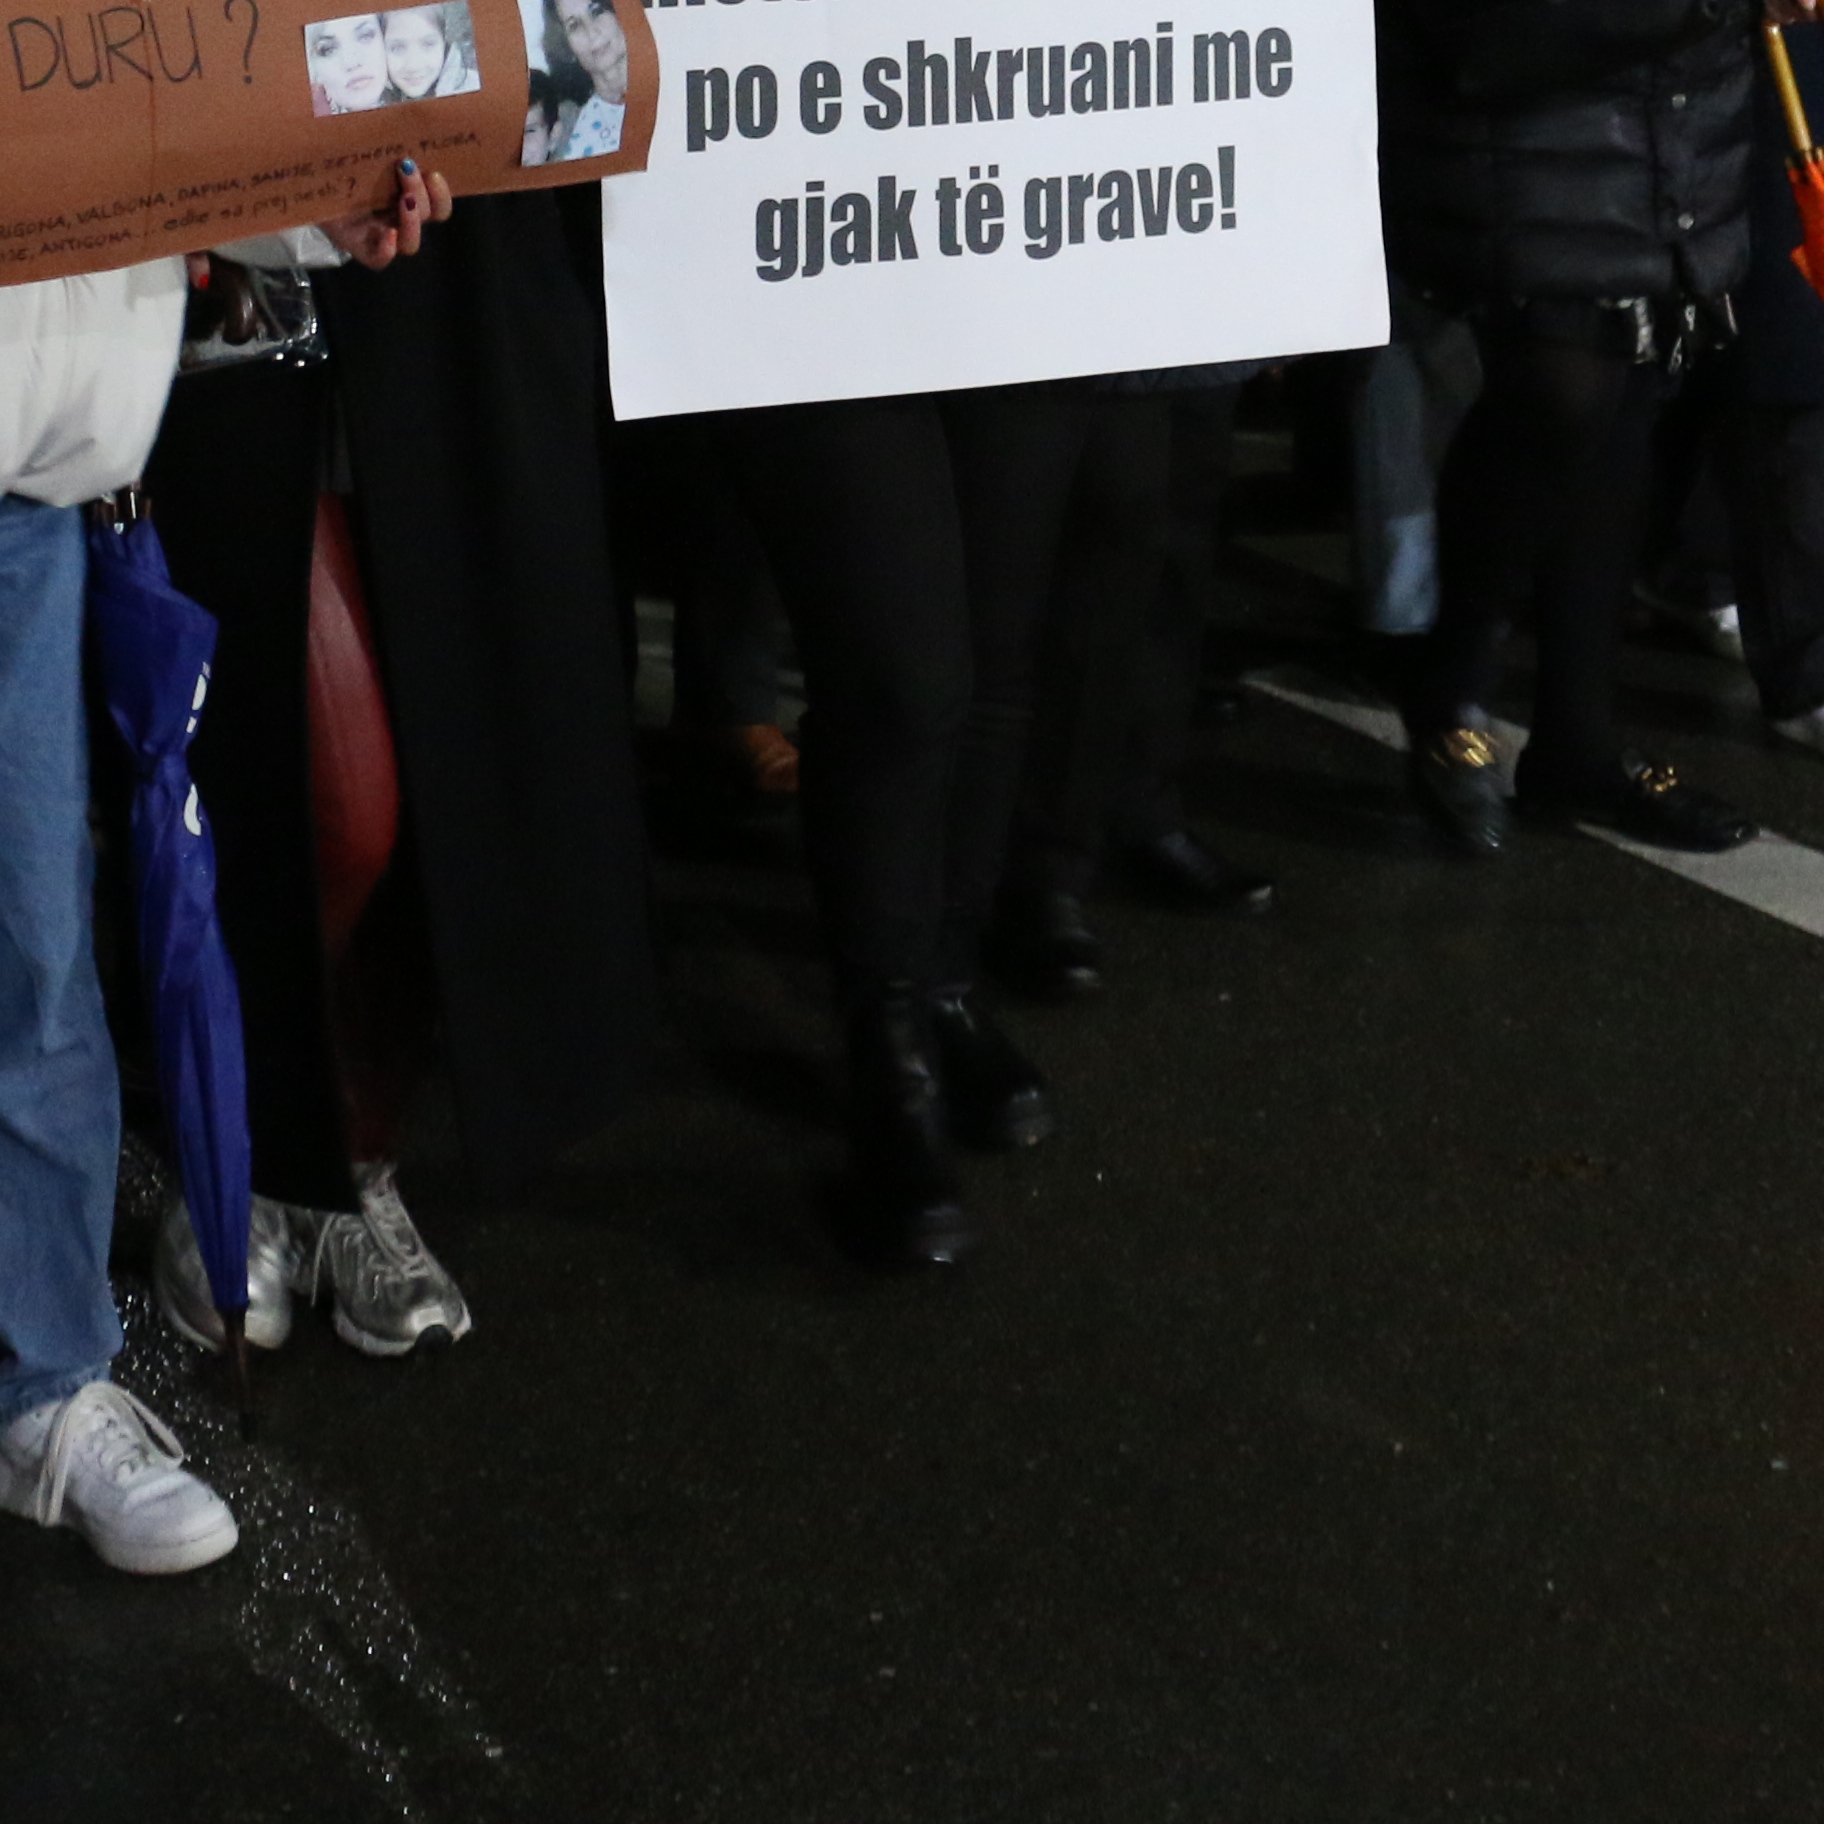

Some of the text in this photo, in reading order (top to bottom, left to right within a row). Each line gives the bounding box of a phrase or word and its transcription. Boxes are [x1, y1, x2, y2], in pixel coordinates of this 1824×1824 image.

[7, 6, 202, 92] DURU
[686, 21, 1294, 152] po e shkruani me
[755, 145, 1237, 283] gjak të grave!
